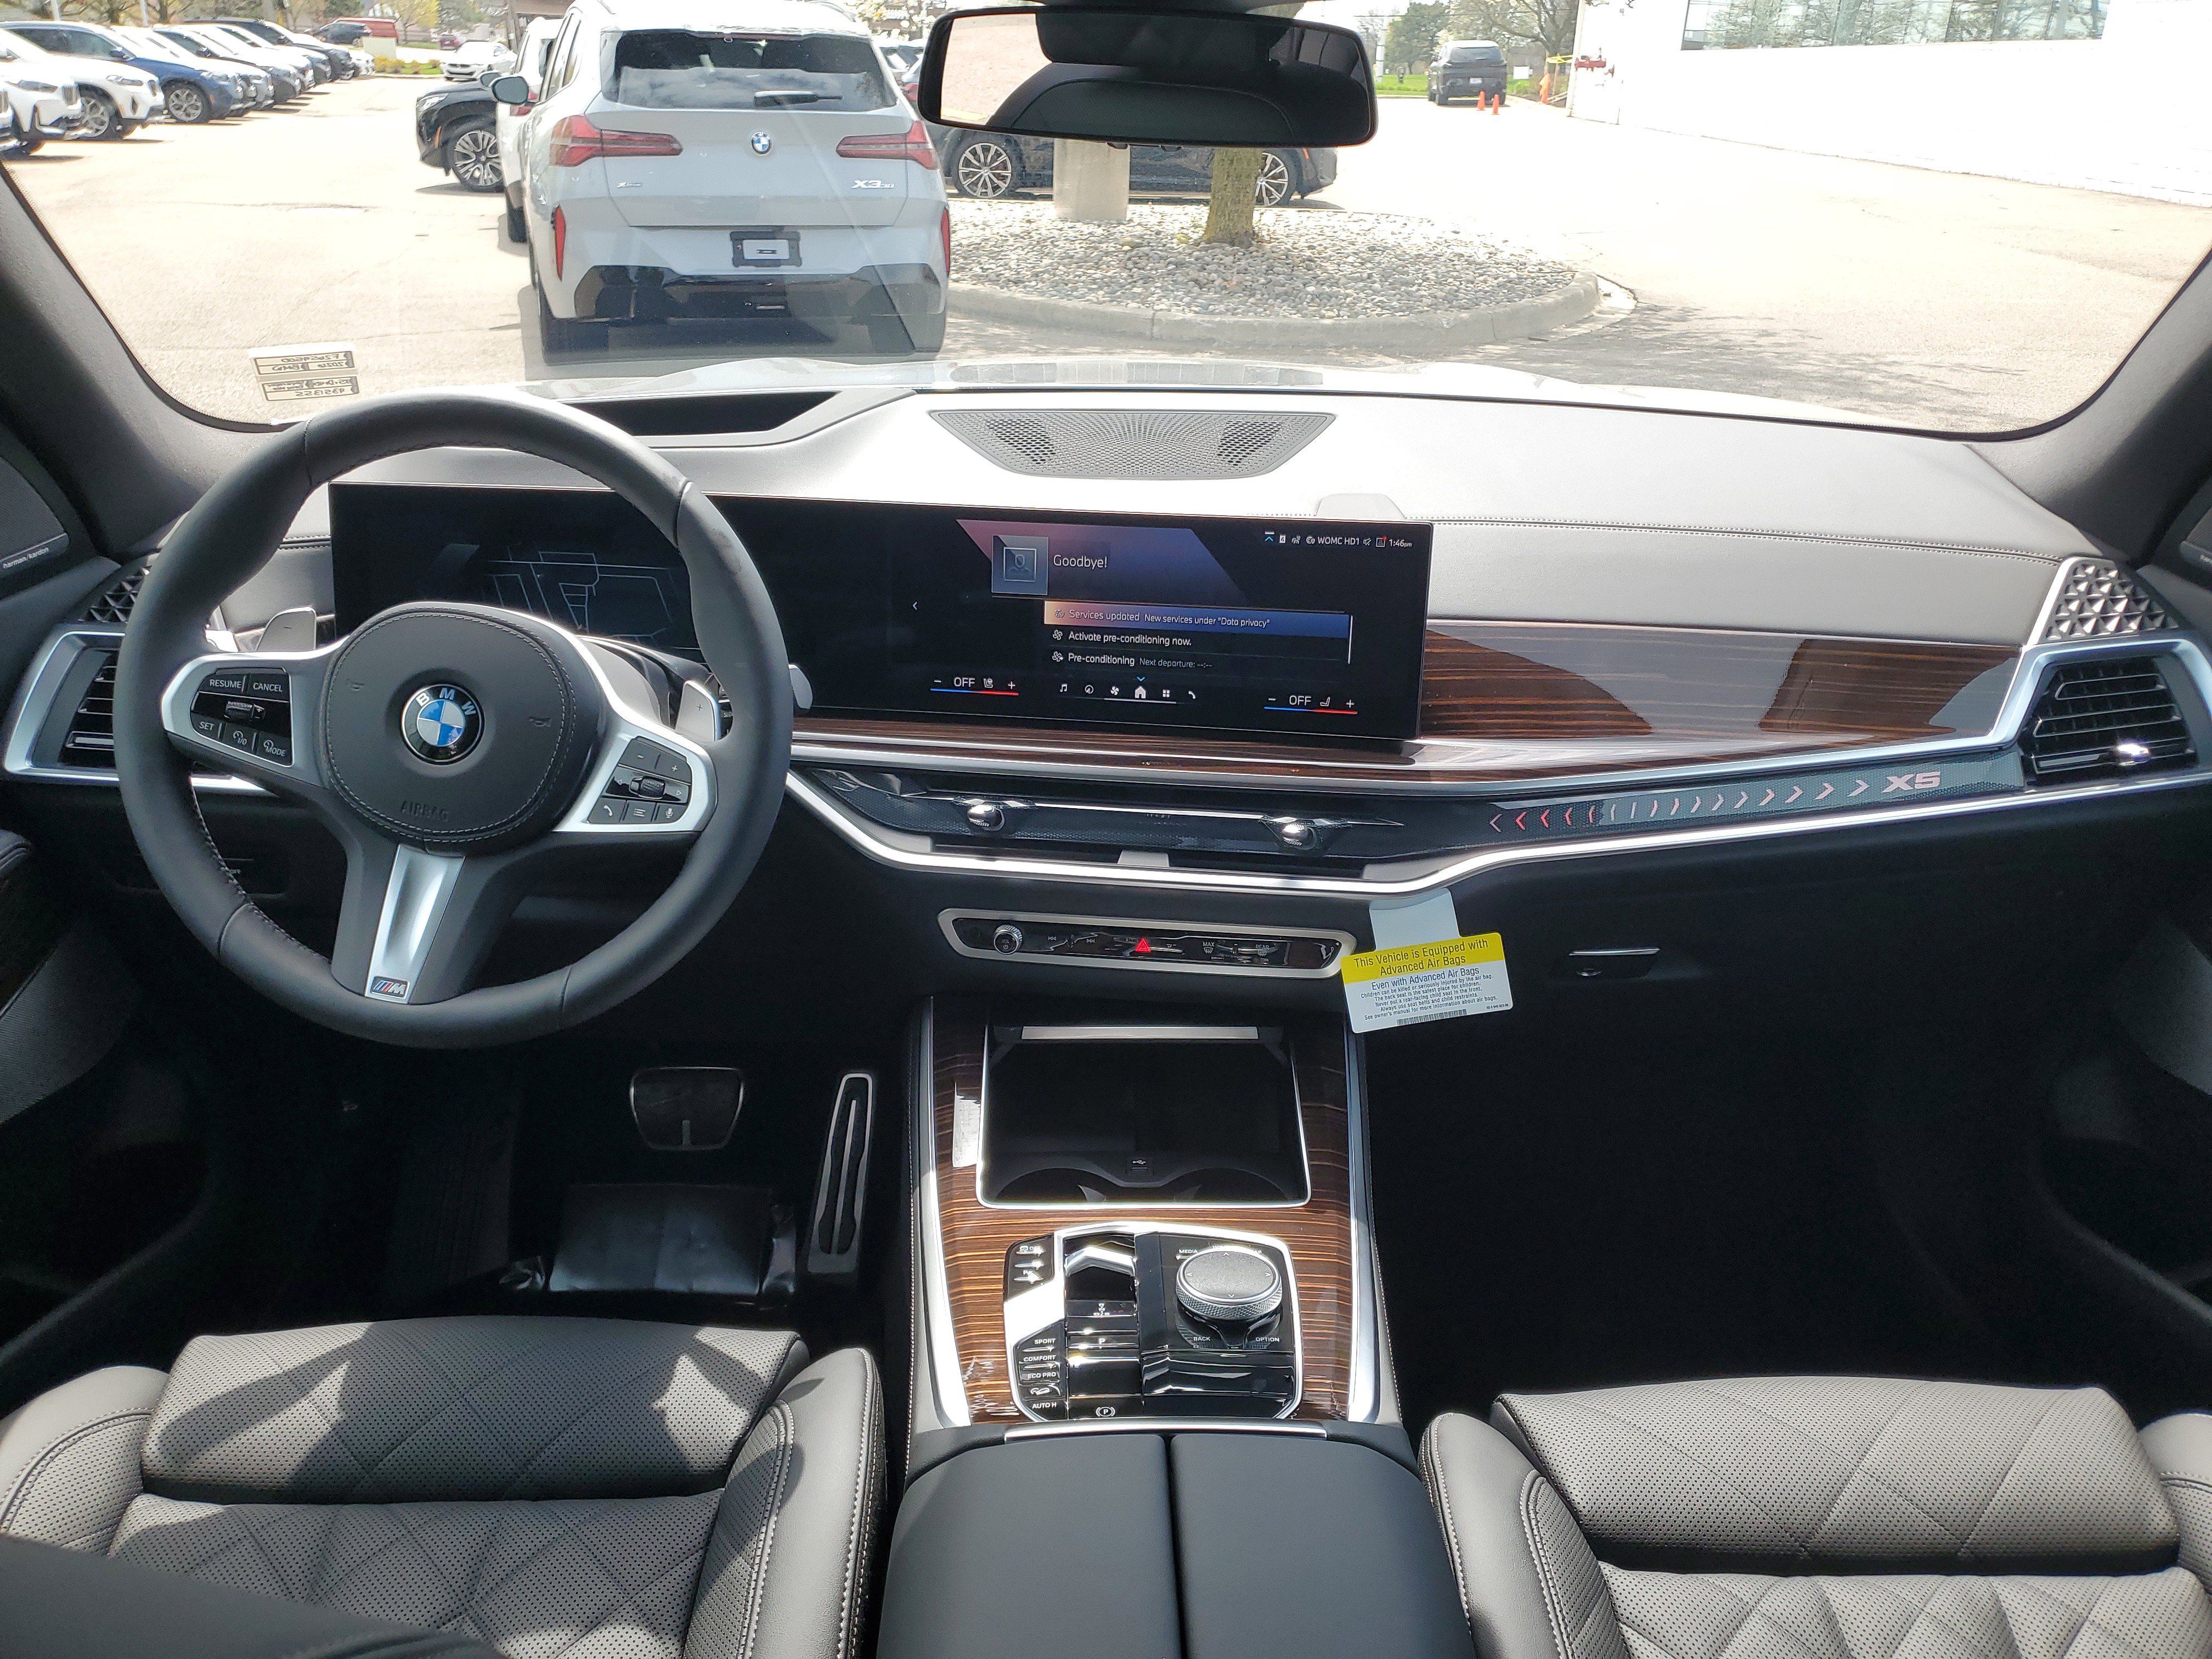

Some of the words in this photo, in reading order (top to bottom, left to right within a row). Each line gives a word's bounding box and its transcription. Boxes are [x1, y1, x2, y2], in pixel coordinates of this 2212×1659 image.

[850, 180, 881, 189] X3
[1318, 536, 1342, 545] WOMC
[1344, 537, 1360, 546] HD1
[1389, 539, 1413, 548] 1:46pm
[1053, 554, 1107, 570] Goodbye!
[1069, 609, 1104, 620] Services
[1106, 612, 1140, 622] updated
[1144, 613, 1161, 622] New
[1163, 615, 1193, 624] services
[1194, 616, 1217, 625] under
[1217, 617, 1239, 626] "Data
[1240, 618, 1270, 628] privacy"
[1068, 631, 1102, 642] Activate
[1103, 634, 1170, 647] pre-conditioning
[1172, 637, 1192, 646] now.
[1068, 652, 1135, 667] Pre-conditioning
[1139, 658, 1156, 667] Next
[1158, 658, 1195, 668] departure:
[210, 679, 242, 689] RESUME
[252, 682, 284, 692] CANCEL
[953, 676, 975, 687] OFF
[415, 687, 477, 716] BMW
[1289, 695, 1312, 706] OFF
[199, 721, 215, 731] SET
[266, 746, 286, 757] MODE
[1881, 771, 1941, 793] X5
[1353, 956, 1374, 968] This
[1375, 951, 1409, 964] Vehicle
[1411, 949, 1420, 959] is
[1422, 941, 1465, 958] Equipped
[1468, 938, 1488, 950] with
[1380, 960, 1424, 976] Advanced
[1427, 958, 1440, 968] Air
[1442, 955, 1466, 966] Bags
[1371, 981, 1390, 990] Even
[1391, 978, 1407, 988] with
[1409, 970, 1446, 984] Advanced
[1448, 969, 1458, 979] Air
[1460, 967, 1480, 977] Bags
[1403, 994, 1429, 1003] rear-facing
[1432, 1000, 1460, 1009] information
